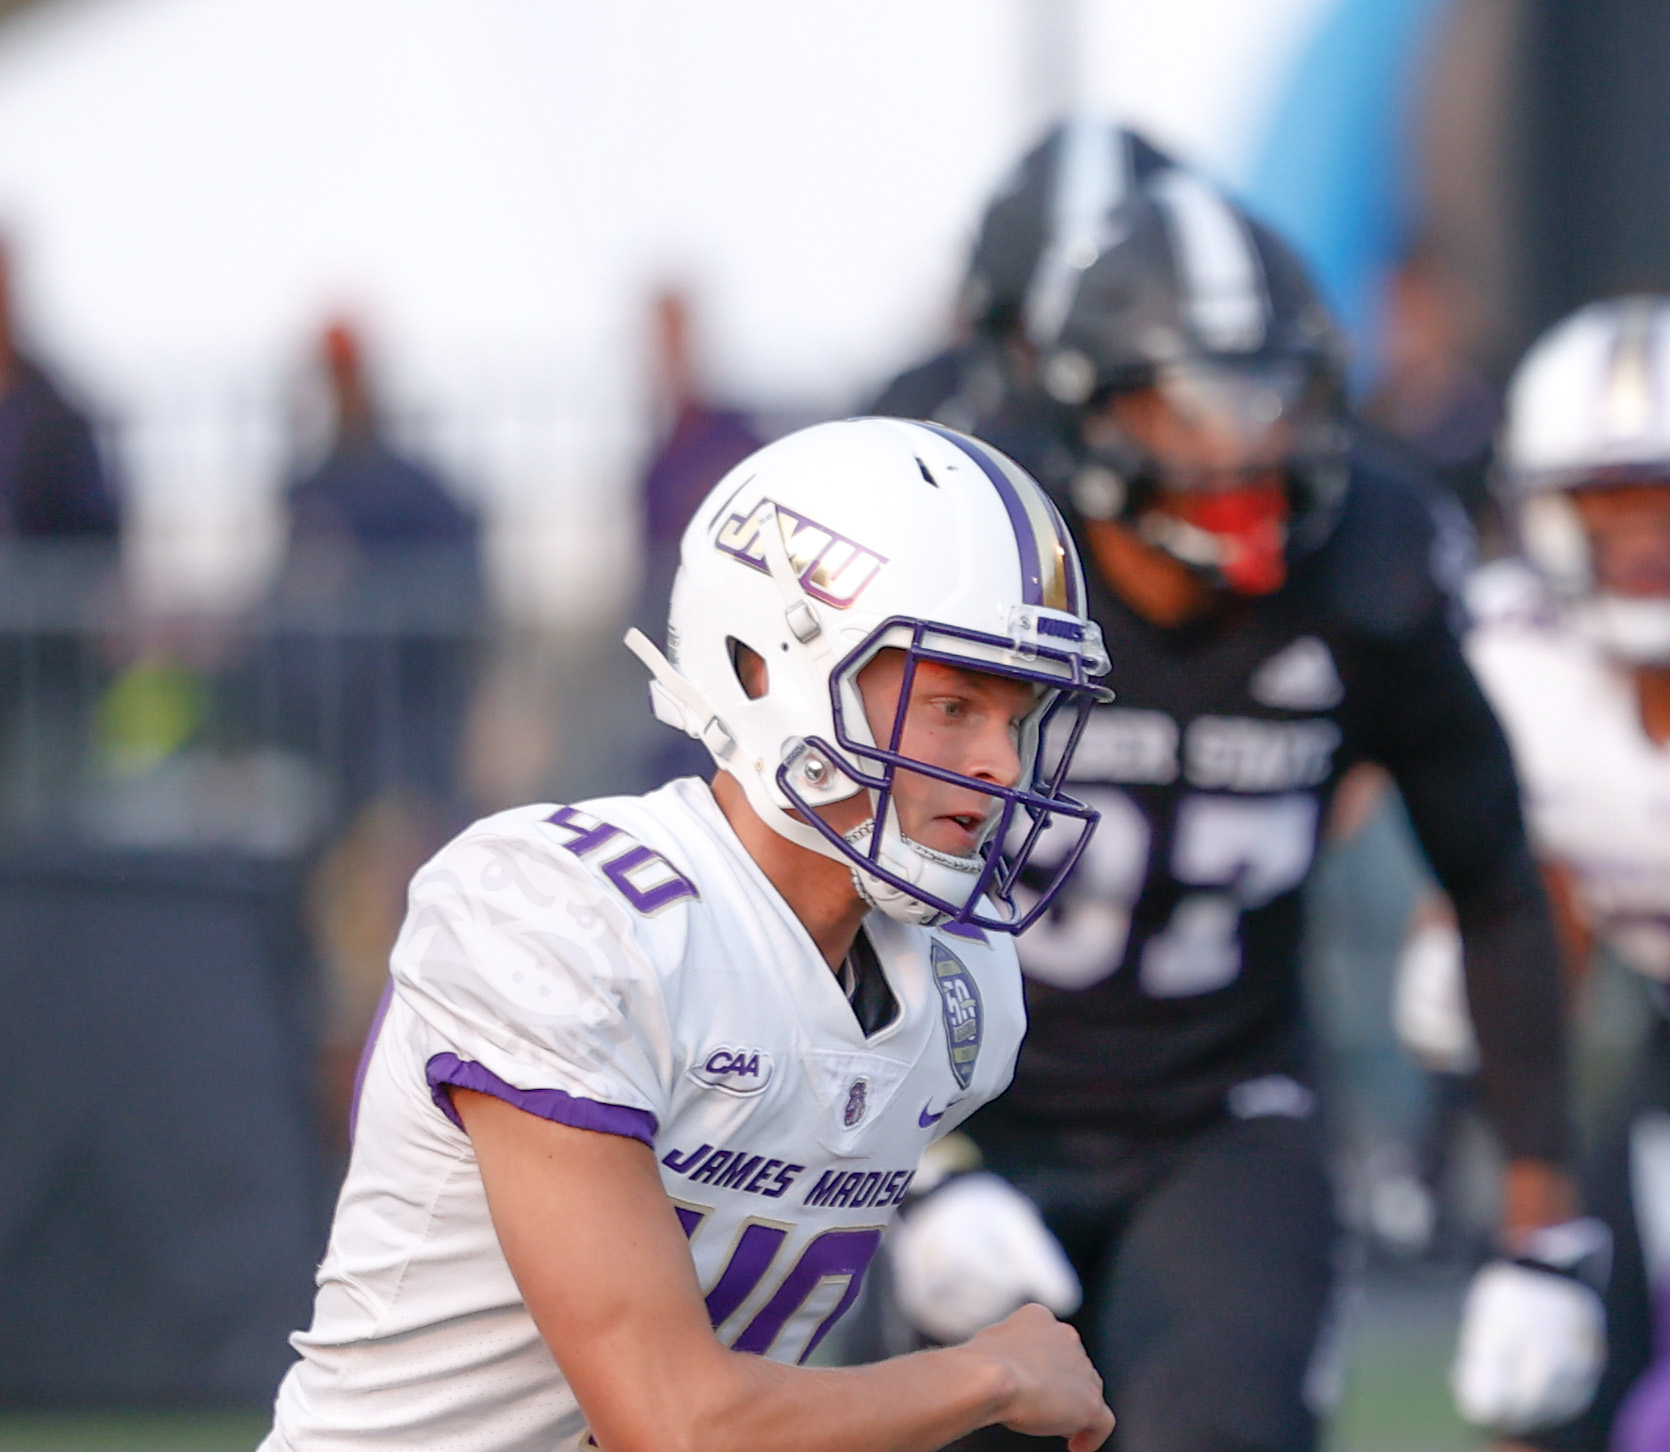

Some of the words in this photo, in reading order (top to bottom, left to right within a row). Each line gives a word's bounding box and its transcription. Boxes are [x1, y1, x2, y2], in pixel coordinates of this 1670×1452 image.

[715, 498, 889, 608] JMU
[543, 806, 701, 917] 40
[706, 1051, 760, 1077] CAA
[662, 1143, 806, 1198] JAMES
